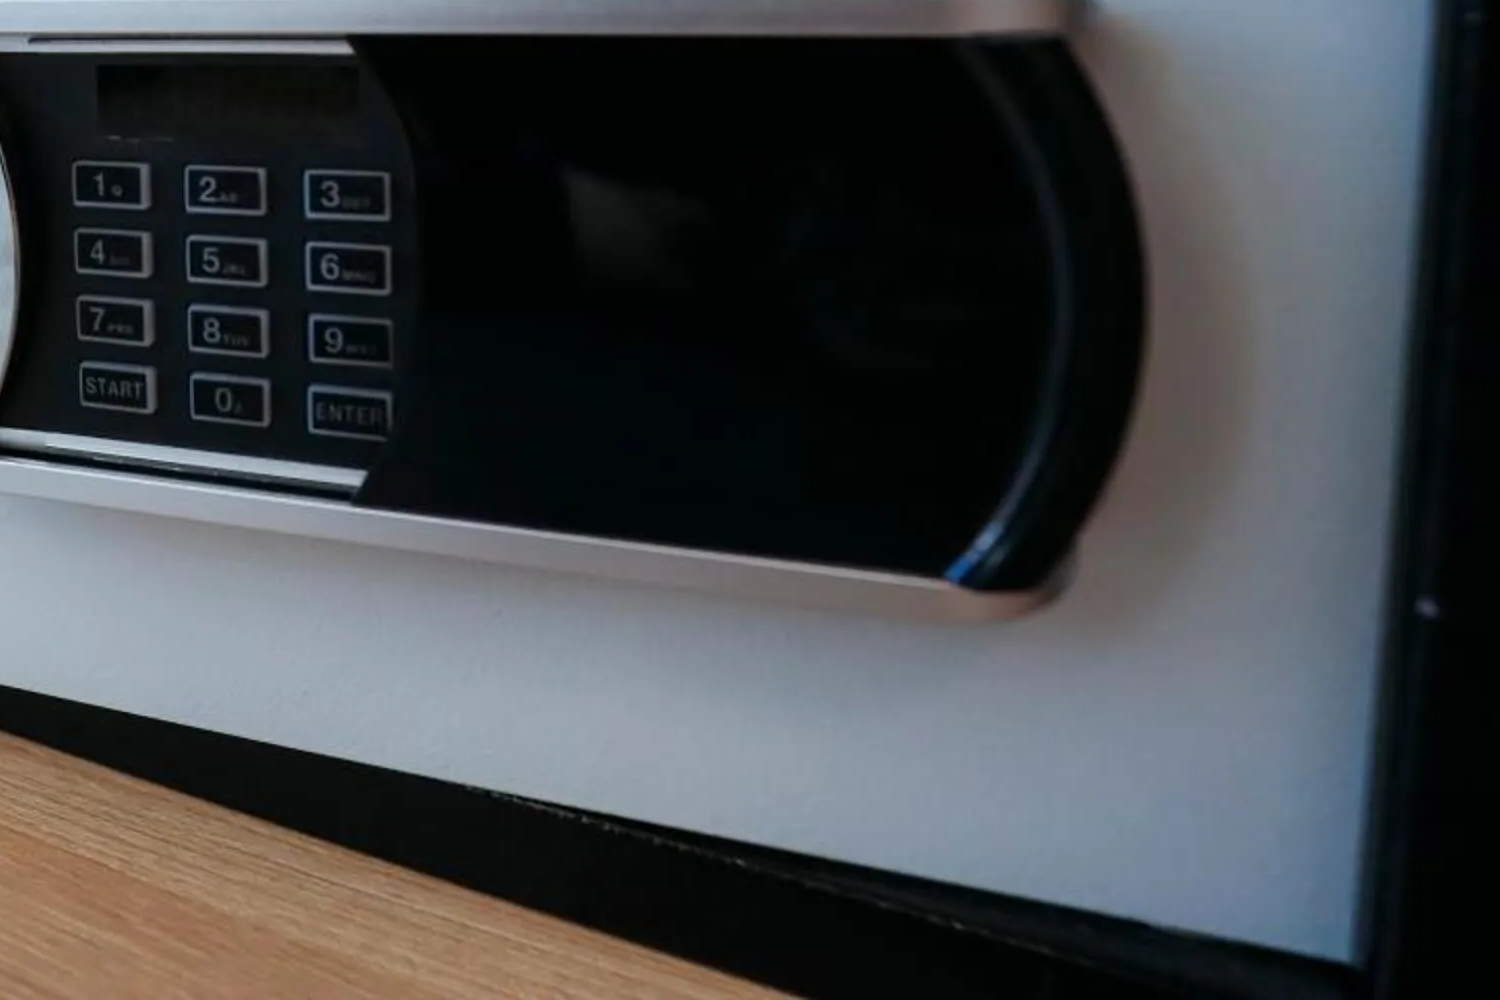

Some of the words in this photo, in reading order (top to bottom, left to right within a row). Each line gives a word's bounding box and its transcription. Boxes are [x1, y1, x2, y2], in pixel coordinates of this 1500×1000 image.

[93, 172, 106, 198] 1
[198, 175, 218, 204] 2
[319, 180, 341, 210] 3
[89, 239, 106, 266] 4
[201, 247, 221, 274] 5
[320, 252, 341, 282] 6
[88, 306, 106, 333] 7
[202, 316, 222, 345] 8
[323, 326, 344, 355] 9
[84, 376, 145, 402] START
[213, 386, 232, 414] 0
[315, 401, 387, 428] ENTER
